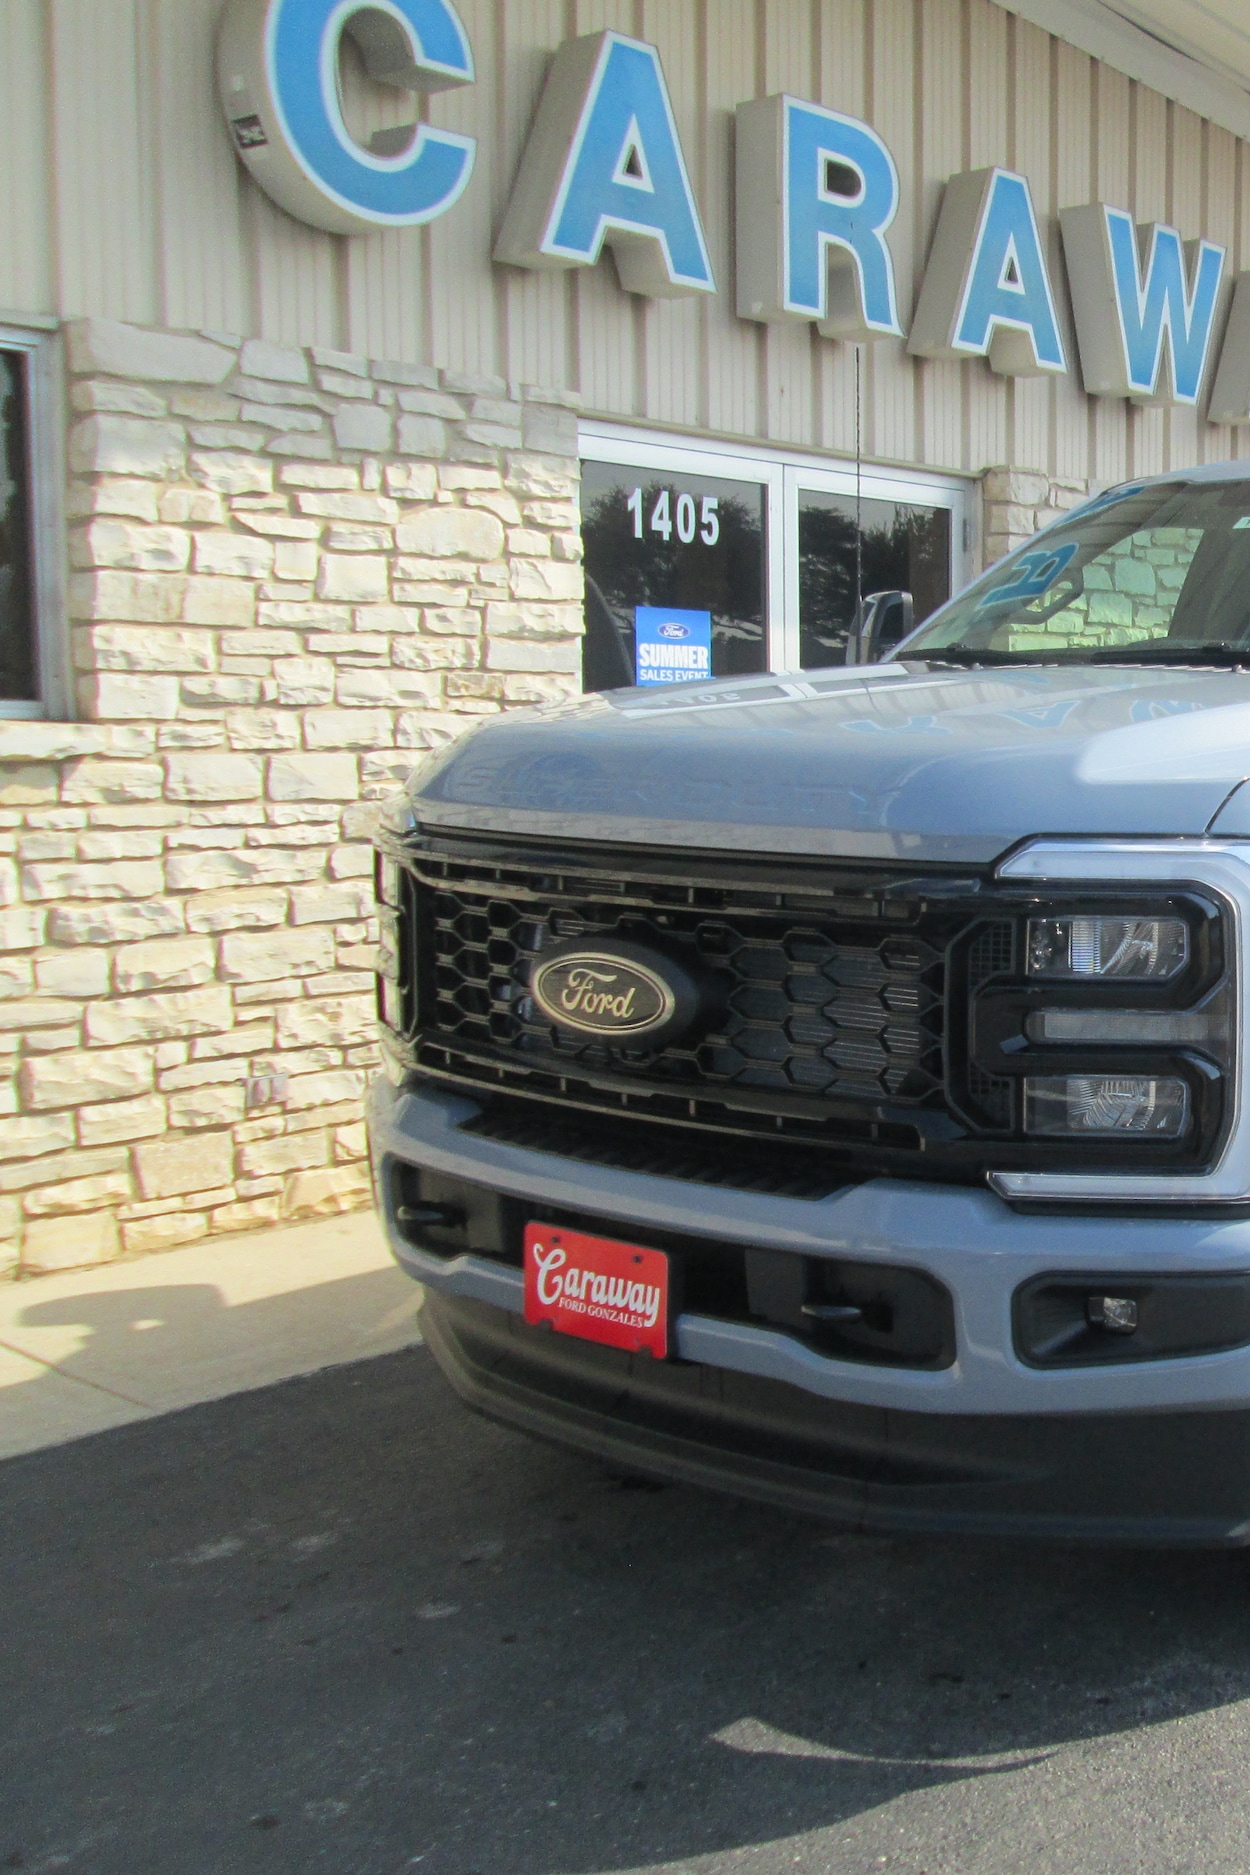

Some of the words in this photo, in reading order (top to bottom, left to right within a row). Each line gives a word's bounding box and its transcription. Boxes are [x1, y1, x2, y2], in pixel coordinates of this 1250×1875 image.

[626, 487, 720, 546] 1405
[639, 643, 709, 669] SUMMER
[640, 669, 673, 682] SALES
[675, 670, 709, 682] EVENT
[561, 968, 637, 1019] Ford
[533, 1243, 661, 1328] Caraway
[558, 1297, 587, 1314] FORD
[587, 1304, 644, 1329] GONZALES
